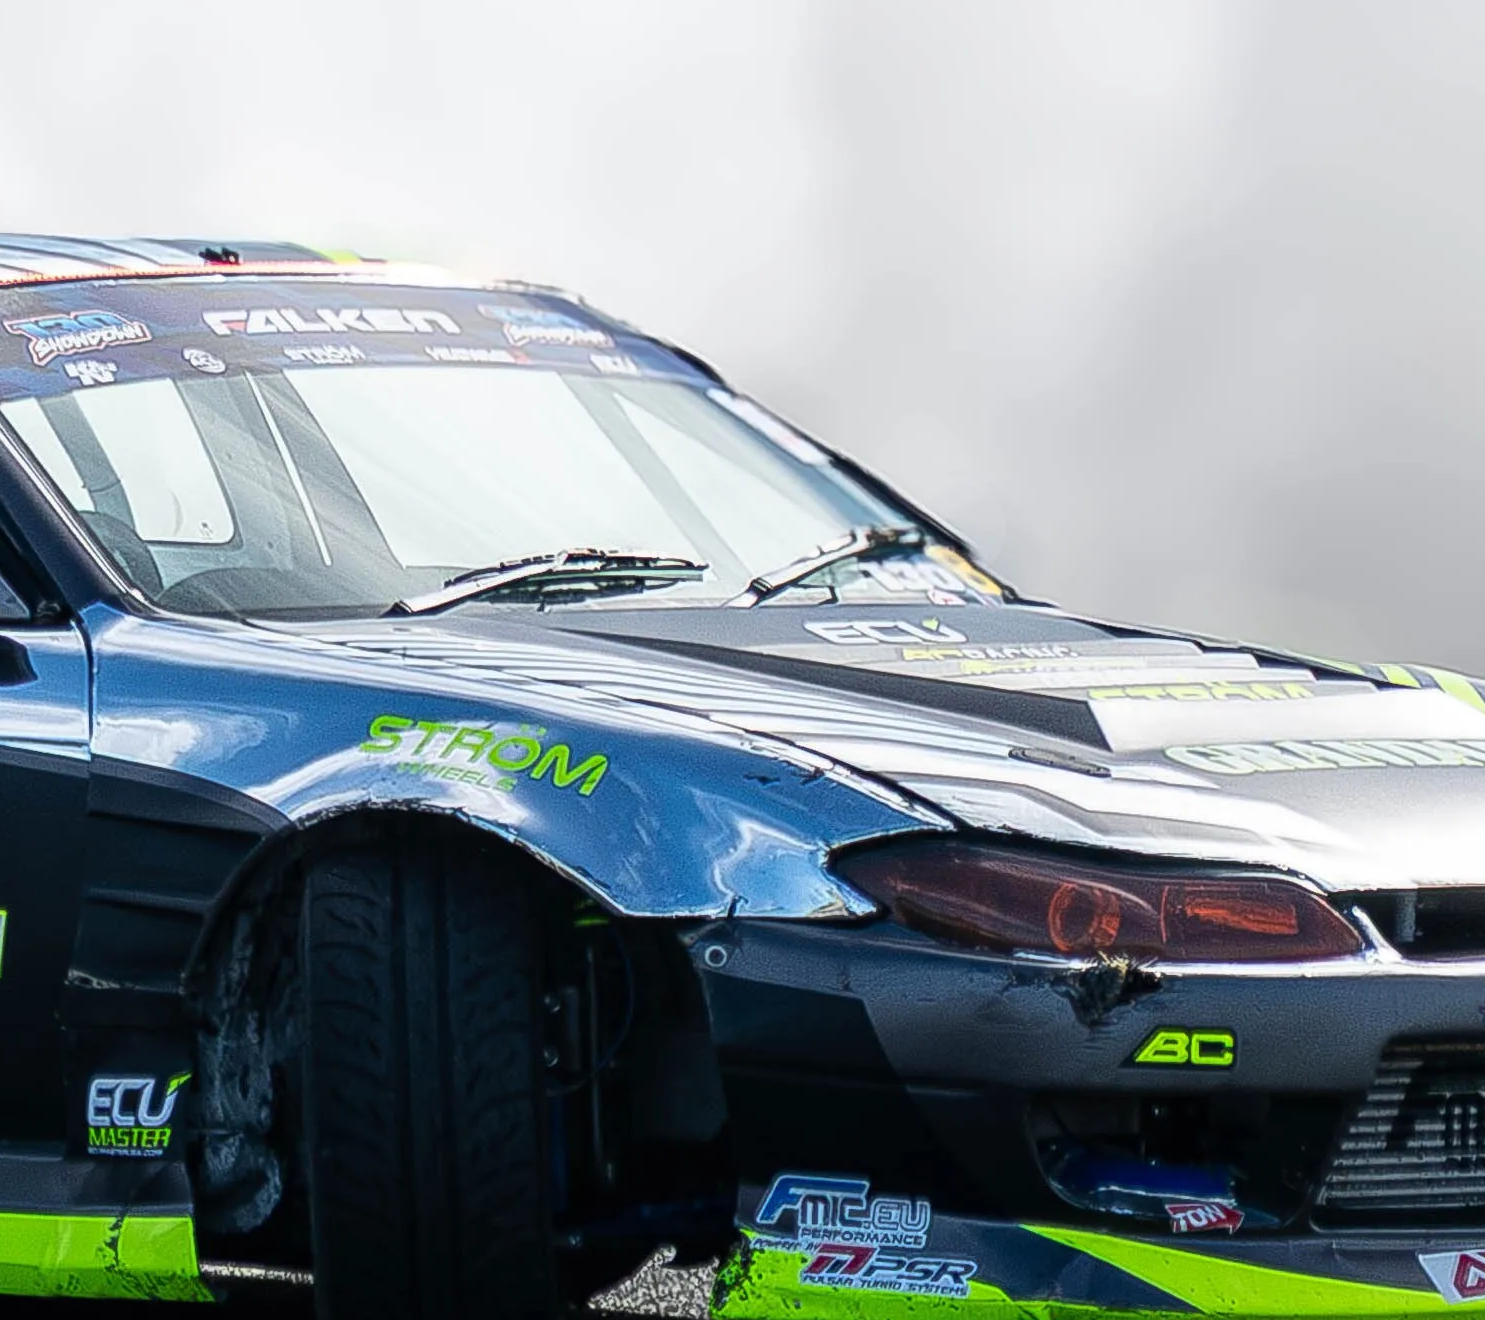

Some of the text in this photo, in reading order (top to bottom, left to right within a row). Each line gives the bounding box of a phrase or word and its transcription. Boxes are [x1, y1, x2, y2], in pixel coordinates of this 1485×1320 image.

[202, 307, 461, 336] FALKEN
[35, 324, 145, 358] SHOWDOWN
[804, 617, 968, 644] ECU
[360, 714, 608, 797] STRÖM
[395, 761, 518, 792] WHEELS
[1134, 1030, 1234, 1066] BC
[89, 1073, 192, 1126] ECU
[88, 1127, 172, 1147] MASTER
[1172, 1205, 1227, 1232] TOW
[801, 1228, 924, 1247] PERFORMANCE
[862, 1255, 977, 1285] PSR
[861, 1279, 902, 1291] TURBO
[905, 1283, 969, 1297] SYSTEMS
